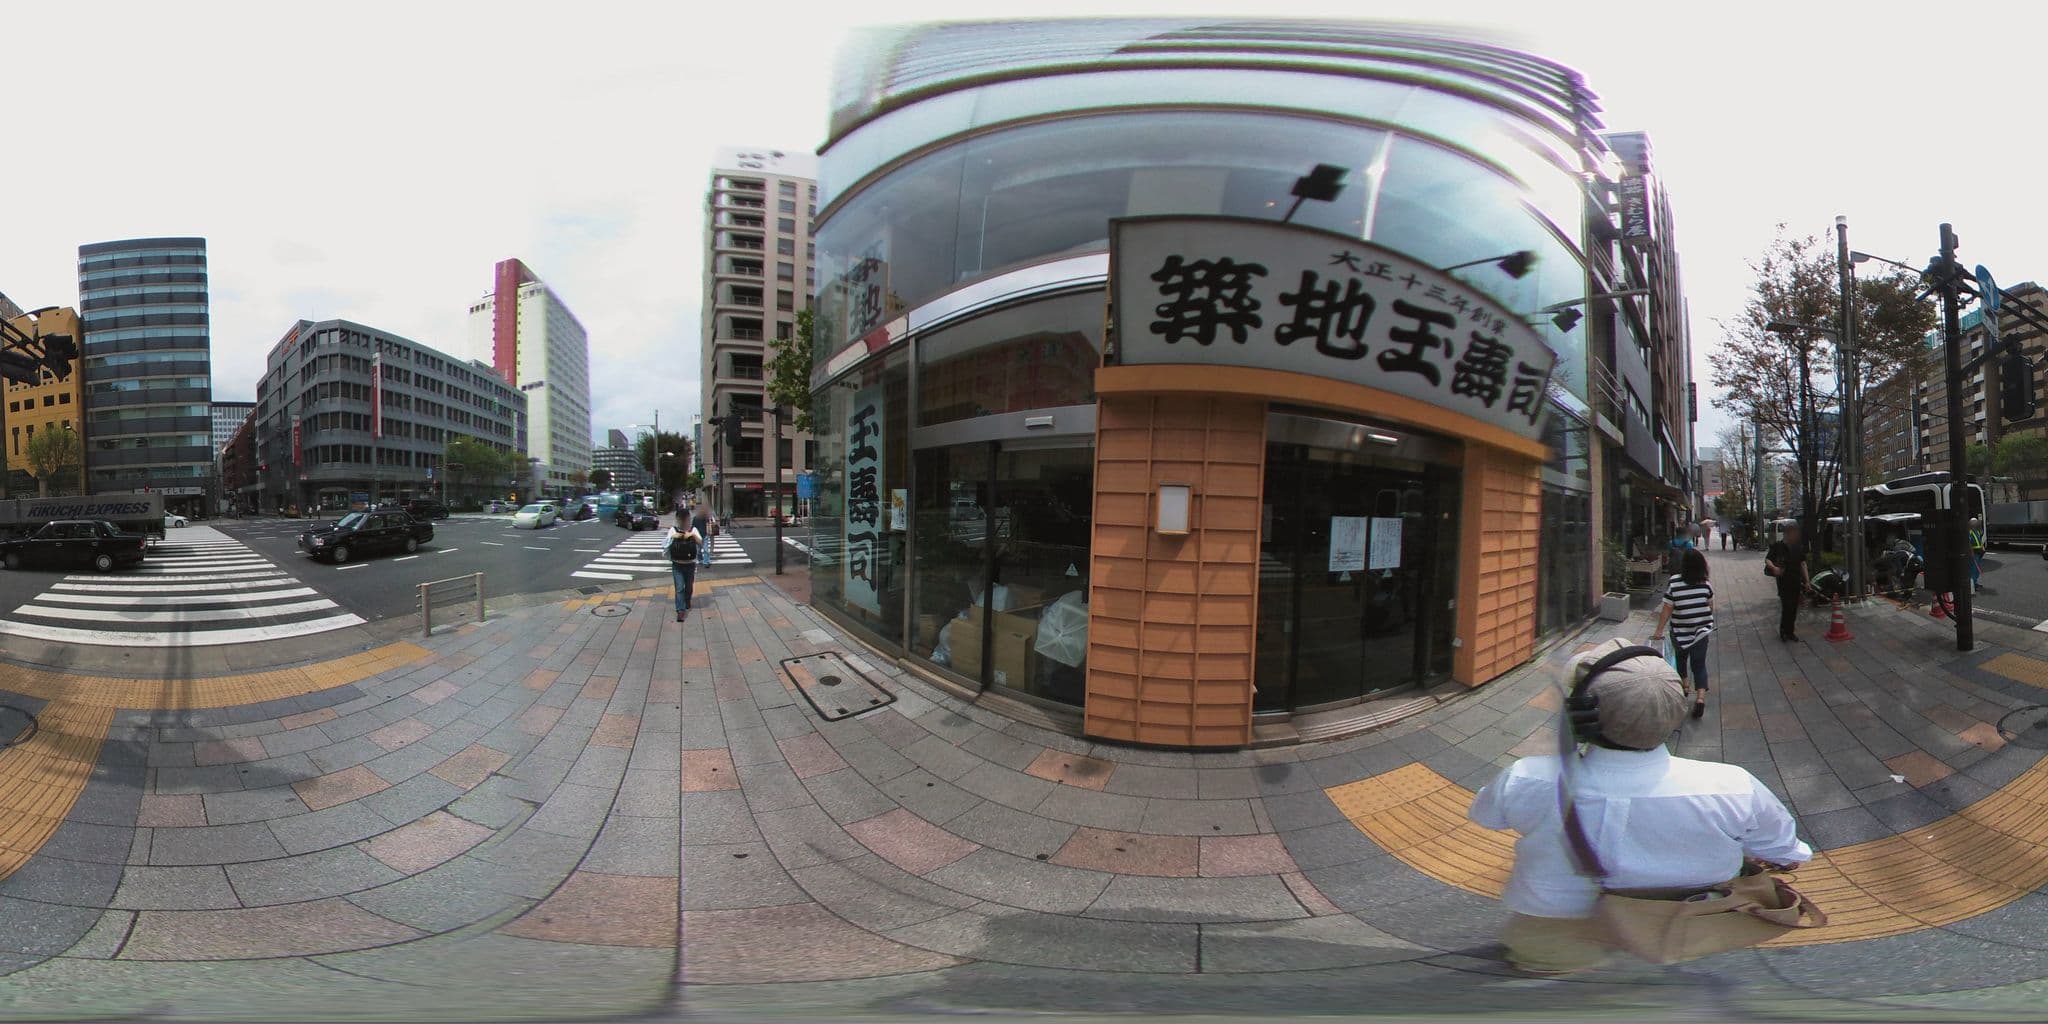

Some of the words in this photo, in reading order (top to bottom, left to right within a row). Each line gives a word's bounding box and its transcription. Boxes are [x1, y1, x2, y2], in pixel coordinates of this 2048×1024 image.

[1328, 250, 1508, 337] 大正十三年創業
[28, 503, 83, 518] KIKUCHI
[85, 502, 150, 515] EXPRESS
